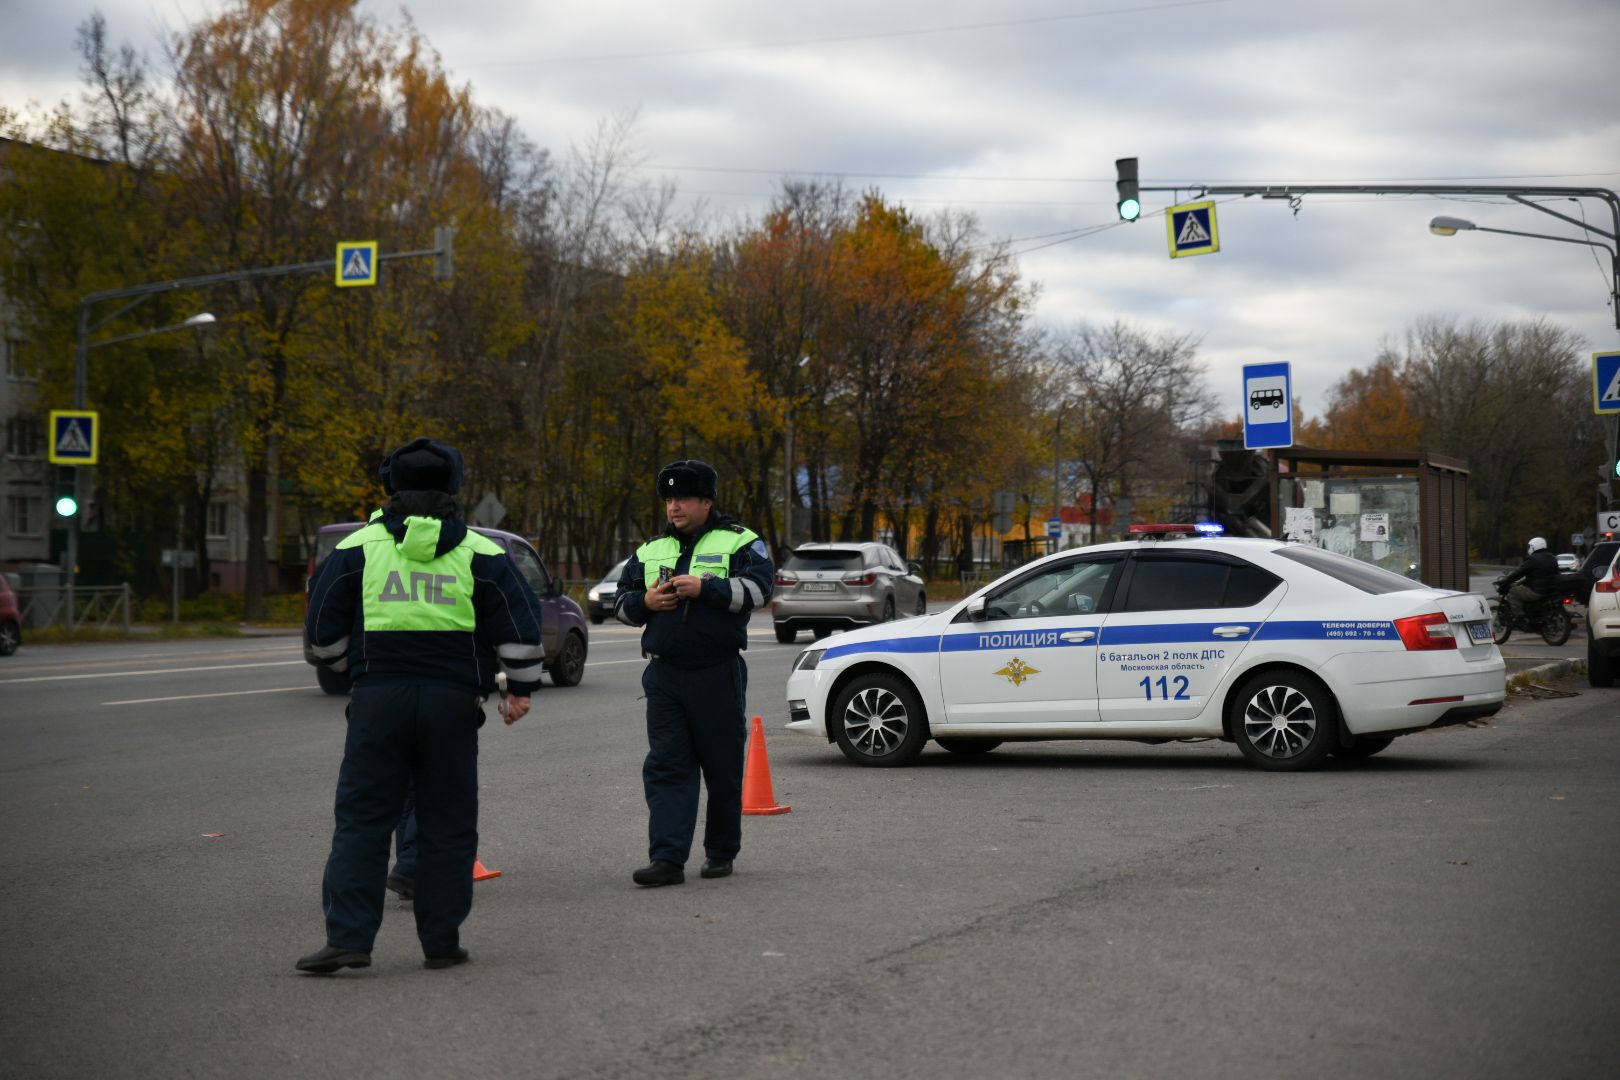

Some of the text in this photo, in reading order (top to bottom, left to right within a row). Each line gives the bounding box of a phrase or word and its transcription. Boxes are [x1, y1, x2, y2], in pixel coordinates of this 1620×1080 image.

[1607, 515, 1620, 529] С
[378, 570, 457, 606] ДПС
[979, 632, 1058, 648] ПОЛИЦИЯ
[1100, 649, 1225, 662] 6 батальон 2 полк ДПС
[1139, 675, 1191, 701] 112
